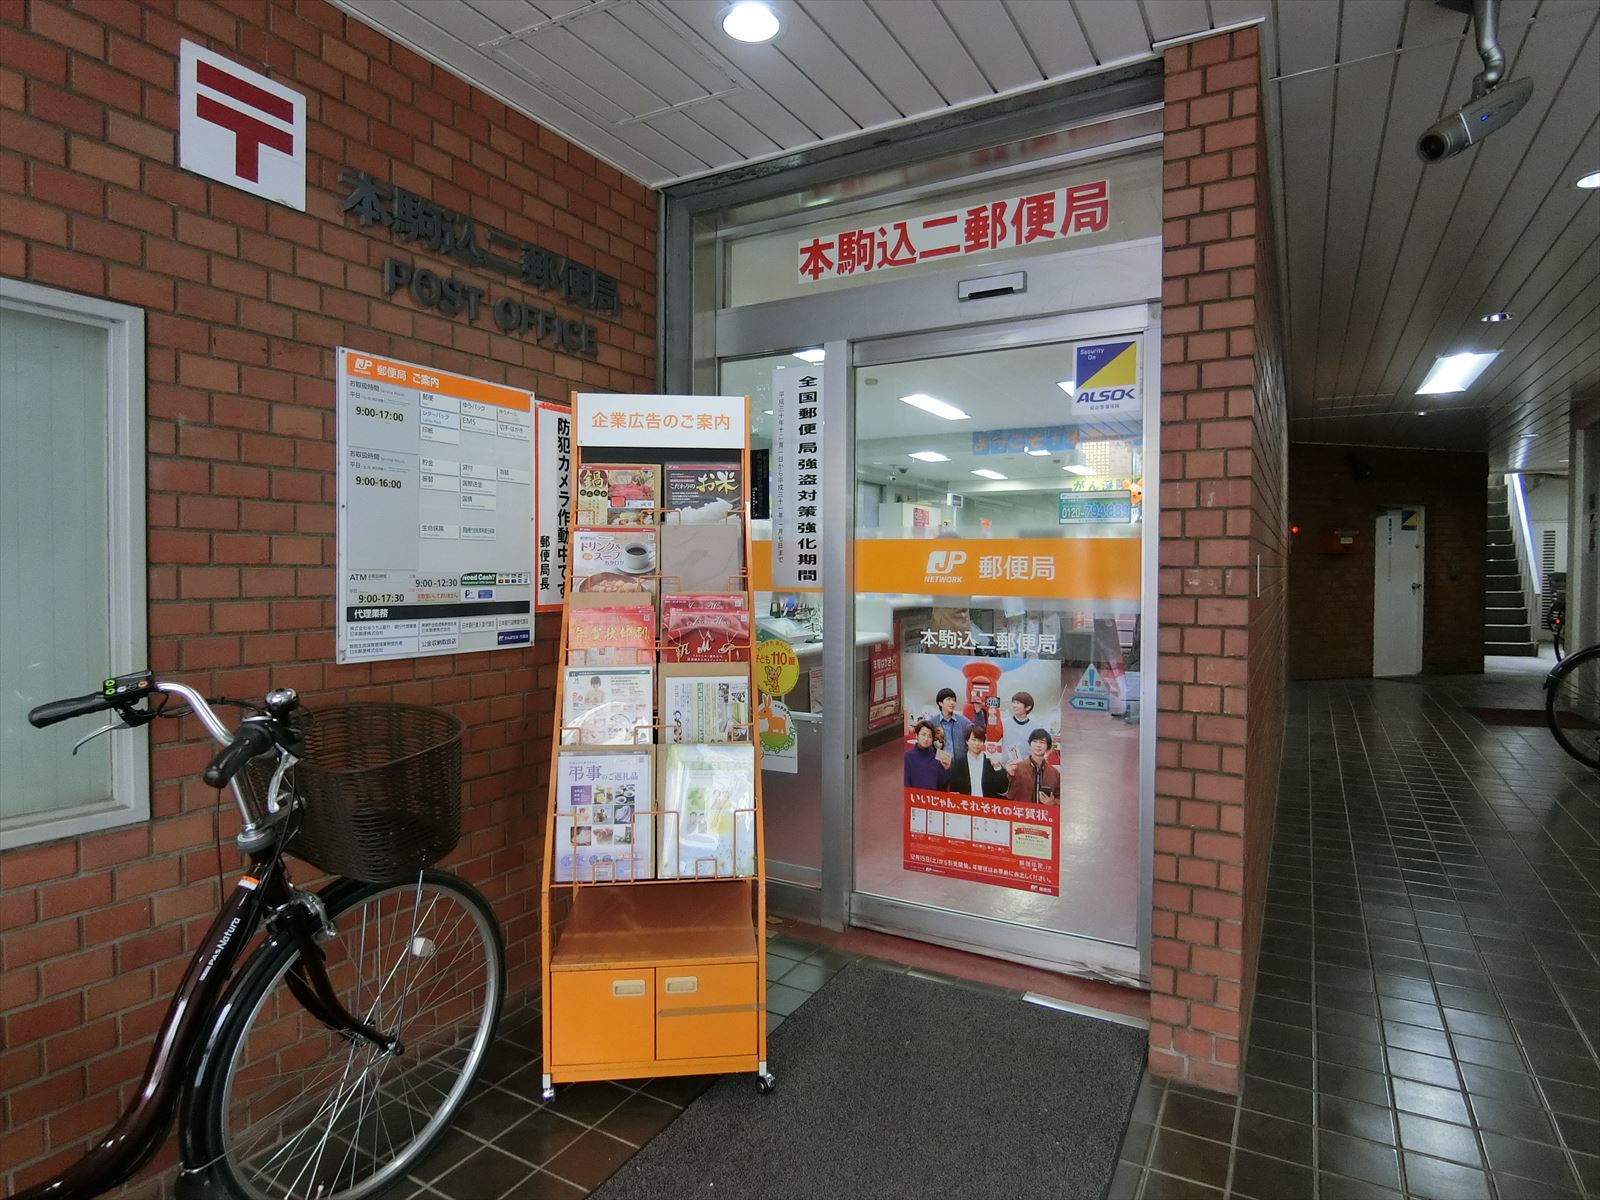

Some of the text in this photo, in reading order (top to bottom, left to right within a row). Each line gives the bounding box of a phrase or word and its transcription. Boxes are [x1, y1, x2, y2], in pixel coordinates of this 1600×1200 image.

[799, 180, 1110, 281] 本駒込二郵便局
[338, 171, 621, 317] 本駒込二郵便局
[384, 256, 600, 356] POST OFFICE
[1080, 348, 1105, 356] Security
[377, 365, 407, 382] 郵便局
[412, 372, 440, 389] ご案内
[1076, 388, 1136, 404] ALSOK
[355, 406, 404, 422] 9:00-17:00
[422, 410, 450, 420] レターパック
[462, 417, 477, 427] EMS
[591, 411, 731, 431] 企業広告のご案内
[355, 475, 402, 490] 9:00-16:00
[797, 375, 818, 582] 全国郵便局強盗対策強化期間
[540, 535, 551, 591] 郵便局長
[926, 550, 1056, 581] JP 郵便局
[350, 573, 367, 581] ATM
[415, 578, 458, 588] 9:00-12:30
[923, 575, 963, 583] NETWORK
[358, 593, 405, 603] 9:00-17:30
[354, 608, 389, 620] 代理業務
[920, 628, 1057, 654] 本駒込二郵便局
[909, 793, 1054, 823] いいじゃん、それぞれの年賀状。
[217, 917, 241, 950] Natura
